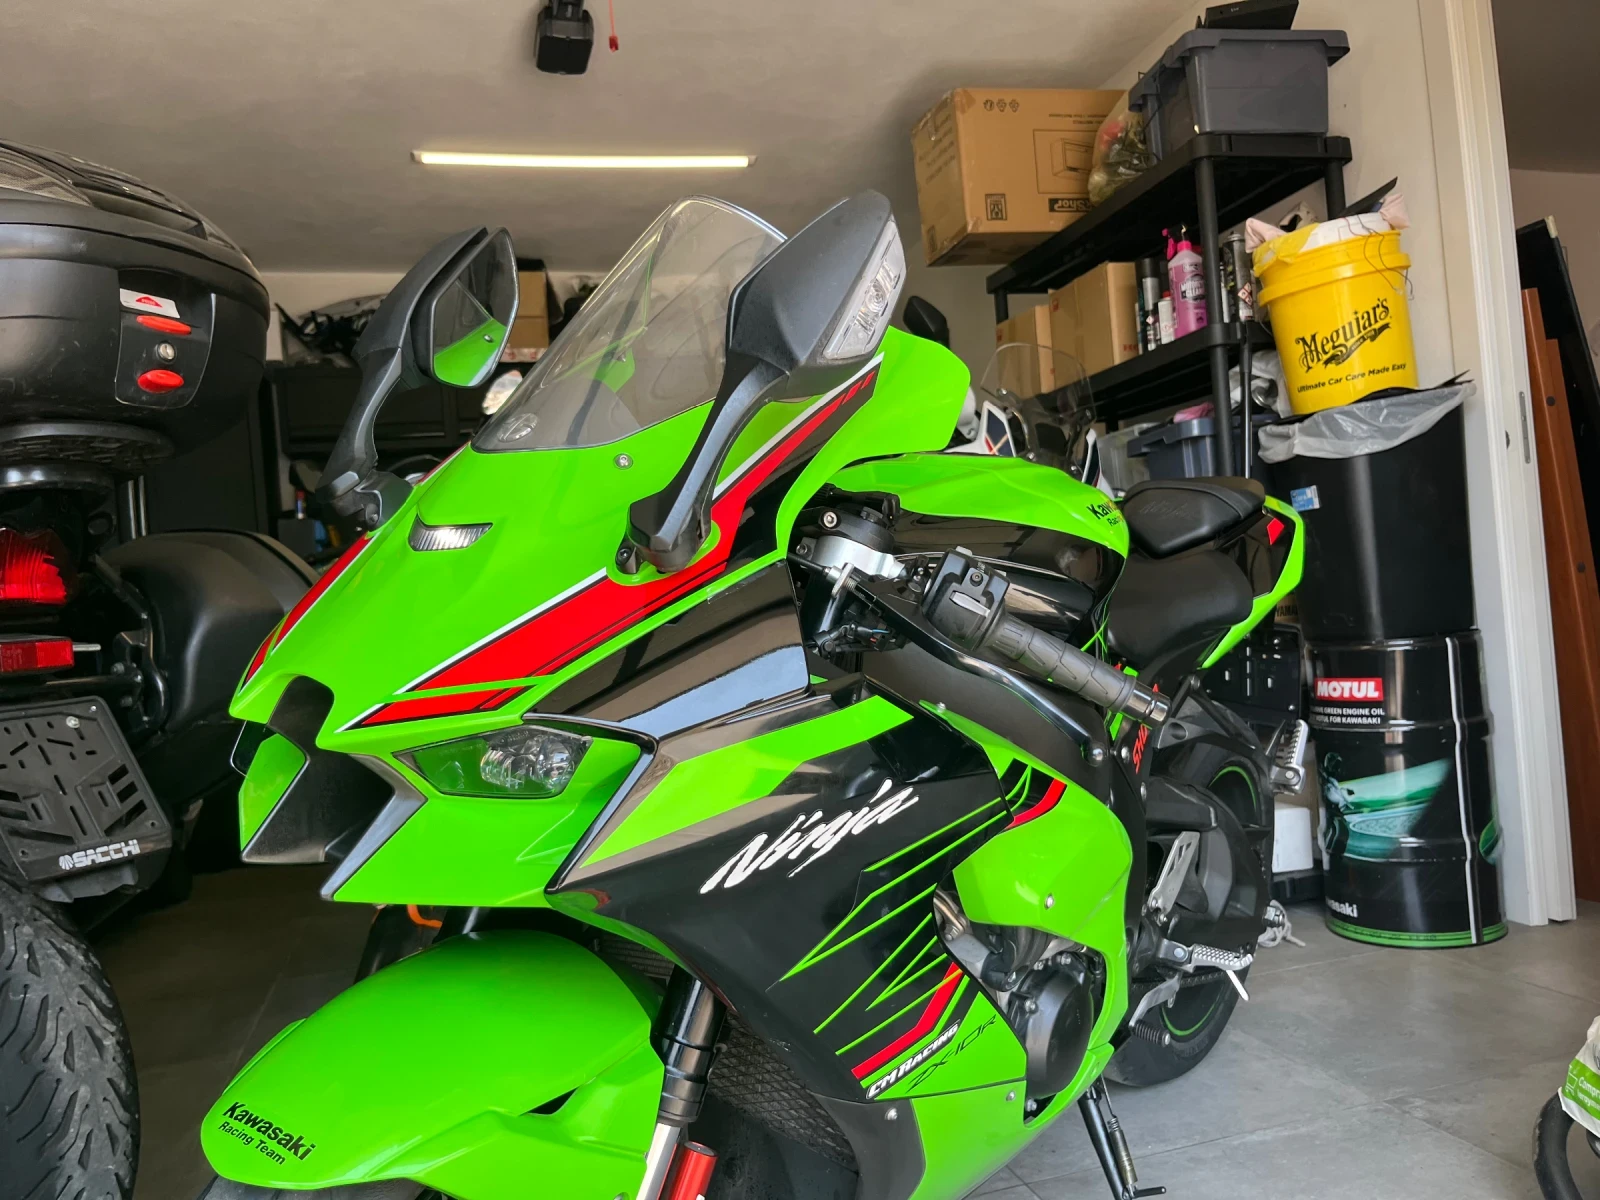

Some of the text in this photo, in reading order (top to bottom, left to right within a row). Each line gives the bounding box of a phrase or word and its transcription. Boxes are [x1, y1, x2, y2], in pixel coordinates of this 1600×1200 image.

[1294, 297, 1392, 374] Meguiar's
[1297, 362, 1407, 393] Ultimate Car Care Made Easy
[1316, 680, 1380, 699] MOTUL
[1342, 707, 1370, 716] ENGINE
[1371, 707, 1385, 716] OIL
[1342, 716, 1381, 725] KAWASAKI
[72, 838, 141, 868] SACCHI
[699, 777, 920, 895] Ninja
[904, 1013, 997, 1095] ZX-10R
[218, 1121, 287, 1166] Racing Team
[222, 1101, 317, 1161] Kawasaki
